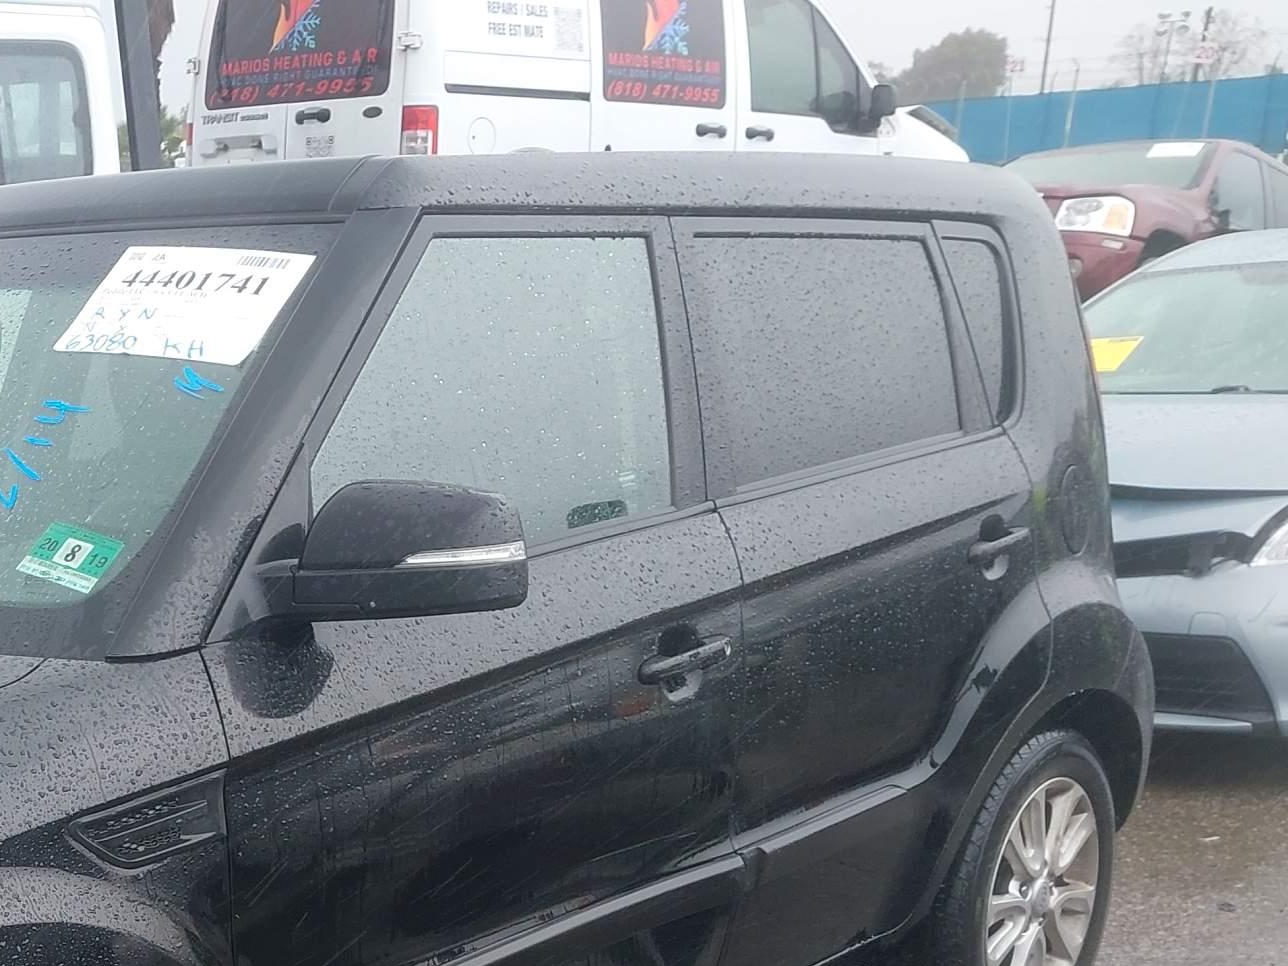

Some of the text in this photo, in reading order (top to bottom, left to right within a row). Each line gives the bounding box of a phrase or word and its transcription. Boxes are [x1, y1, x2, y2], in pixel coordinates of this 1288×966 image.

[488, 1, 518, 15] REPAIRS
[526, 4, 549, 18] SALES
[488, 22, 506, 35] FREE
[222, 58, 270, 76] MARIOS
[274, 51, 333, 71] HEATING
[337, 50, 347, 65] &
[608, 52, 649, 68] MARIOS
[651, 55, 693, 72] HEATING
[607, 80, 720, 103] (818) 471-9955
[121, 268, 270, 296] 44401741
[39, 536, 108, 568] 20 8 19
